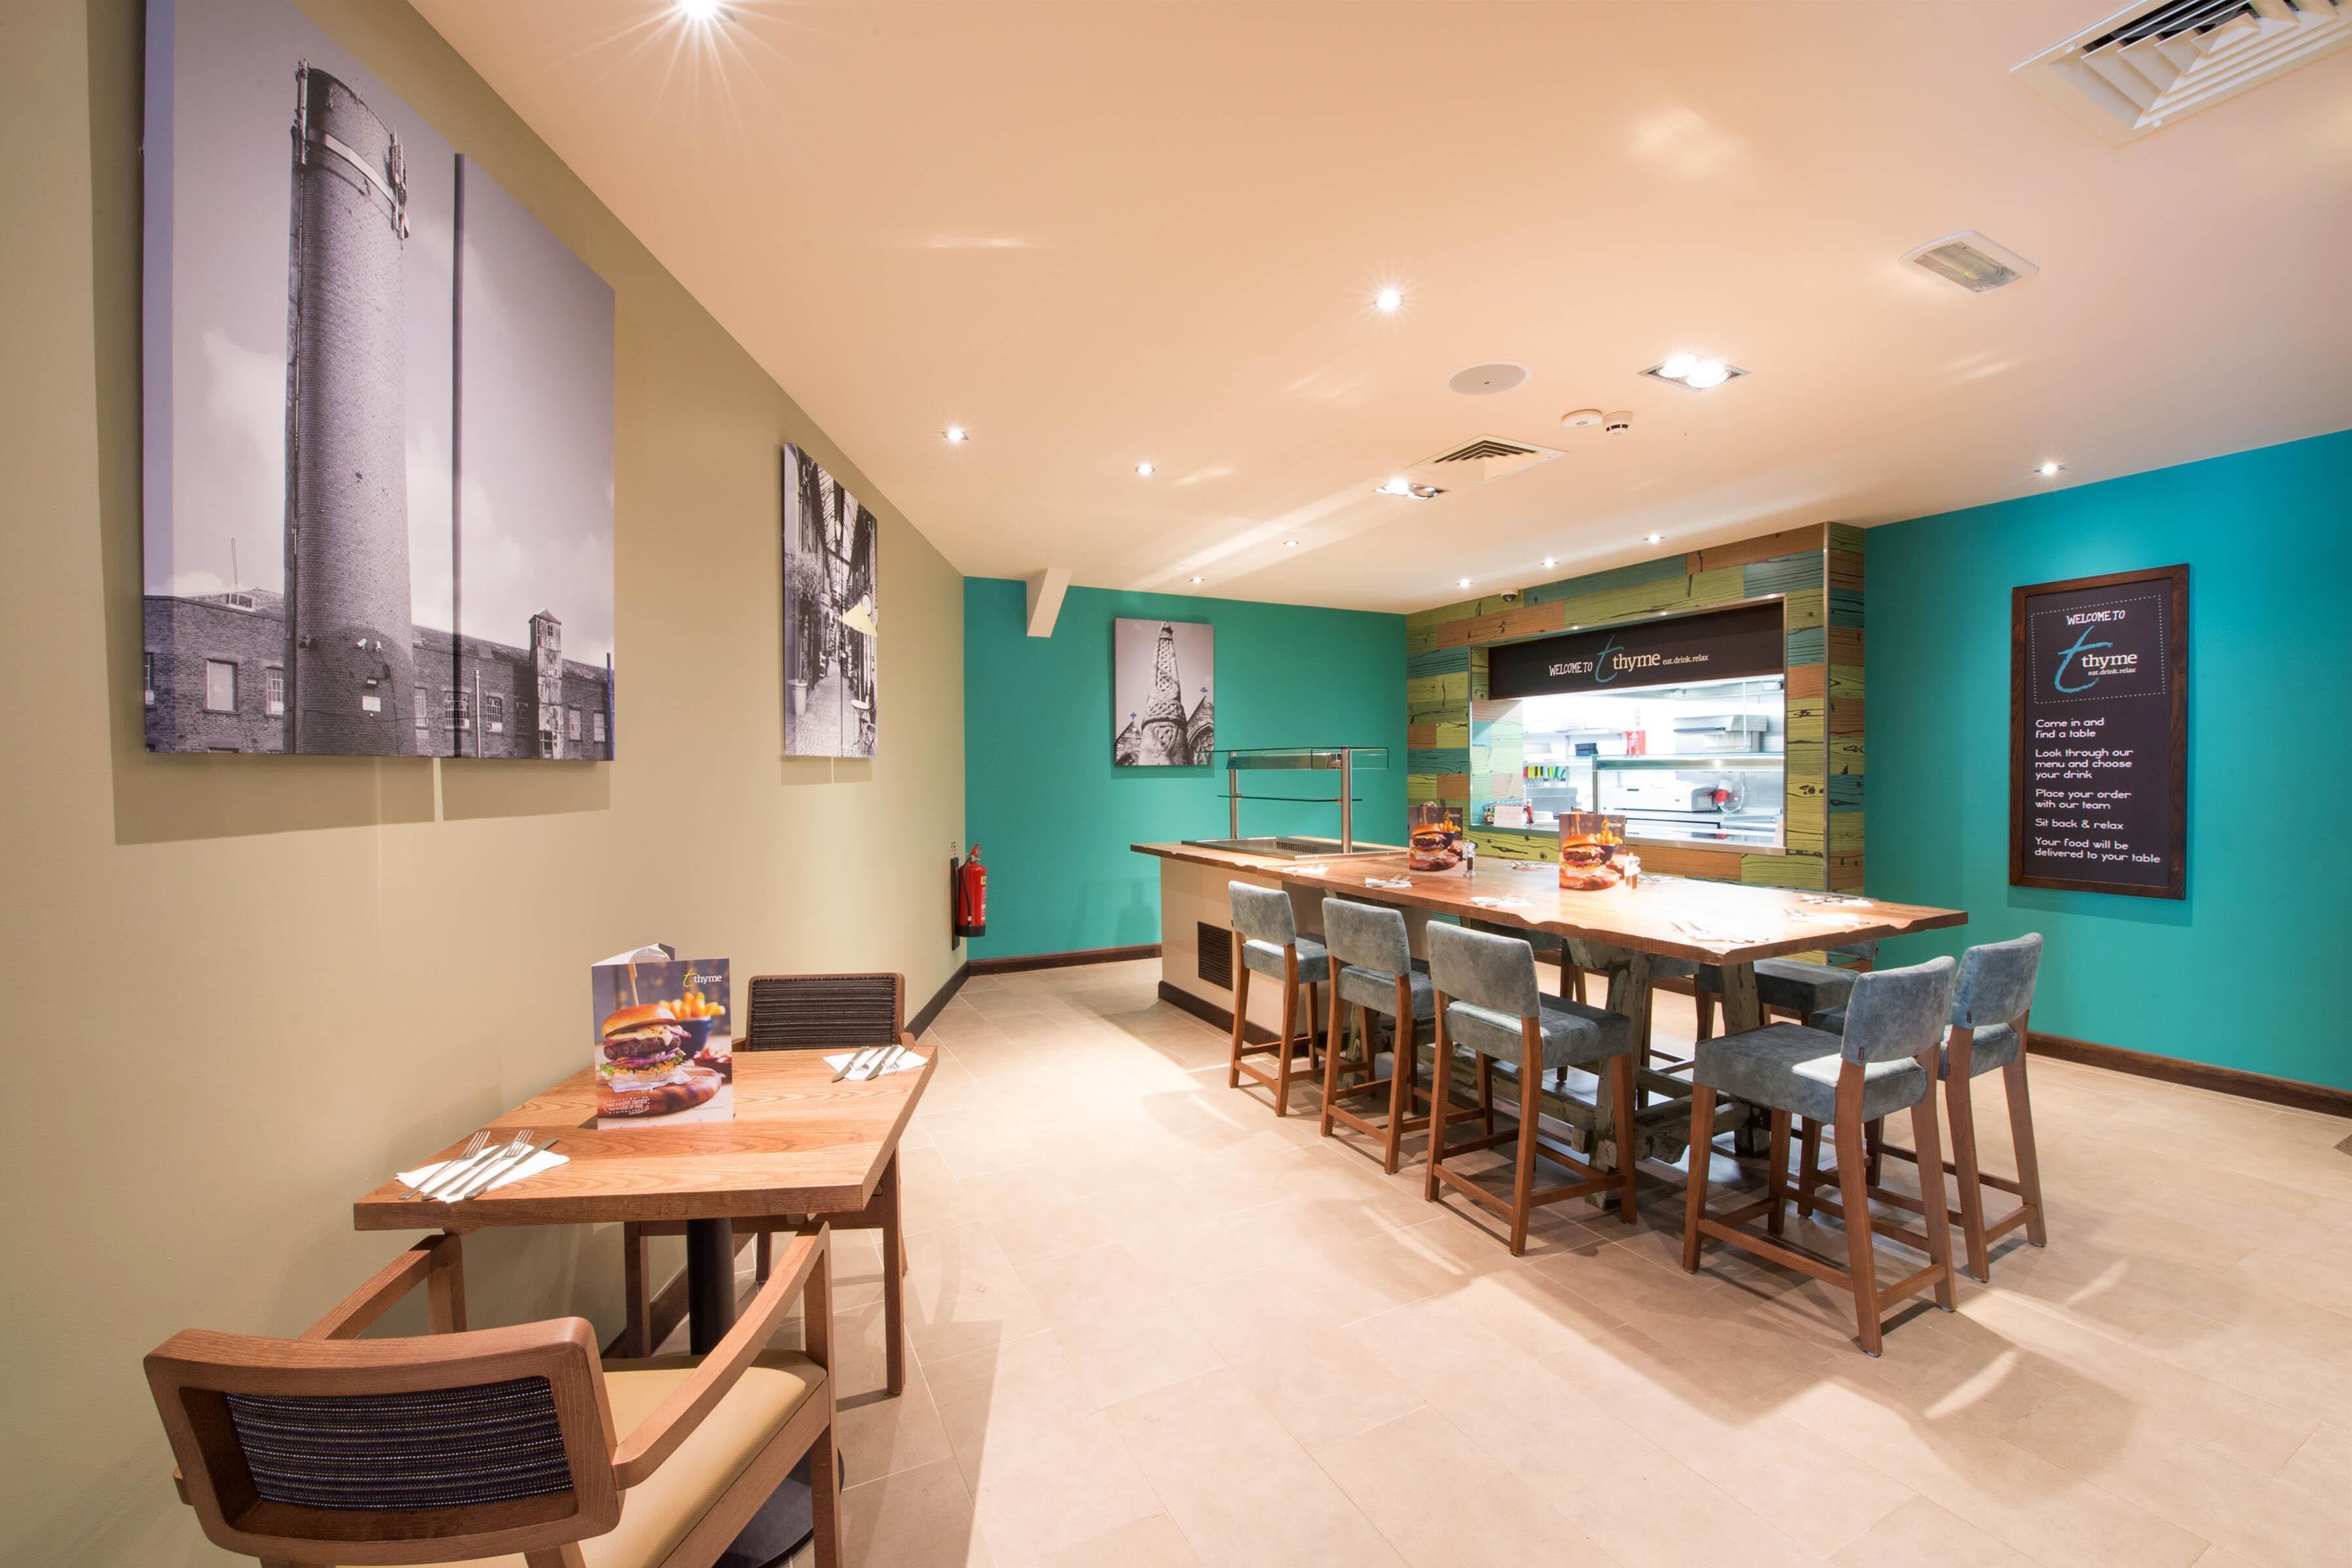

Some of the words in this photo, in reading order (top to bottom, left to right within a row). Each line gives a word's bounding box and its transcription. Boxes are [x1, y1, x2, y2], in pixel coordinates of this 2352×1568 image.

[2066, 611, 2111, 625] WELCOME
[2112, 610, 2125, 621] TO
[1548, 662, 1582, 676] WELCOME
[1582, 661, 1593, 673] TO
[1612, 653, 1660, 672] thyme
[1662, 654, 1708, 665] eat.drink.relax
[2081, 653, 2138, 669] thyme
[2036, 719, 2067, 728] Come
[2083, 717, 2104, 727] and
[2070, 729, 2096, 738] table
[2065, 749, 2108, 759] through
[2068, 759, 2088, 768] and
[2035, 772, 2060, 781] your
[2063, 770, 2092, 779] drink
[2036, 789, 2065, 798] Place
[2068, 791, 2093, 800] your
[2035, 818, 2048, 826] Sit
[2052, 819, 2078, 828] back
[2081, 820, 2090, 828] &
[2035, 837, 2061, 846] Your
[2064, 838, 2089, 847] food
[2114, 841, 2129, 850] be
[2034, 849, 2083, 858] delivered
[2132, 854, 2161, 863] table
[694, 974, 722, 985] thyme
